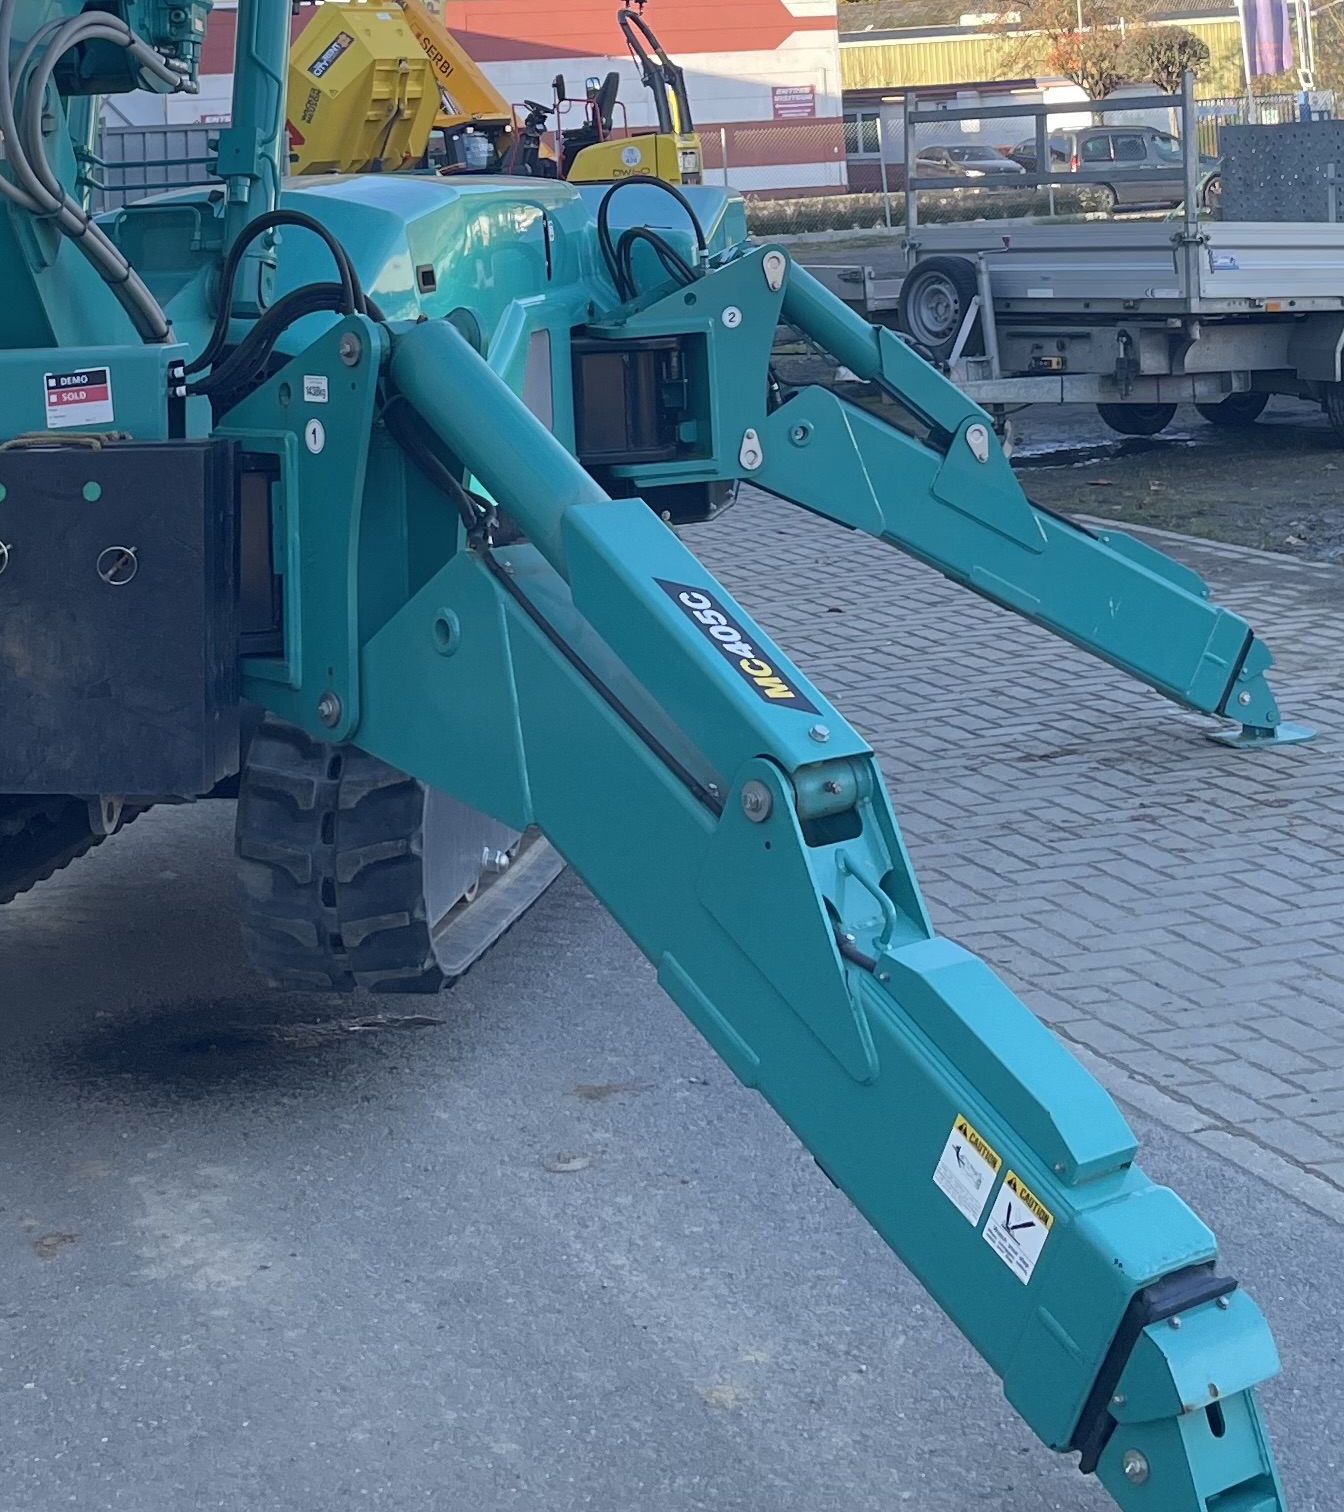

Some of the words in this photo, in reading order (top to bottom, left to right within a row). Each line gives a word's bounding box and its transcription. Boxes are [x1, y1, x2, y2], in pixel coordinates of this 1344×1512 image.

[314, 59, 329, 77] CITY
[421, 37, 454, 78] SERBI
[728, 312, 736, 323] 2
[60, 375, 88, 386] DEMO
[61, 391, 87, 402] SOLD
[678, 591, 796, 699] MC405C
[969, 1132, 999, 1170] CAUTION
[1019, 1187, 1050, 1226] CAUTION
